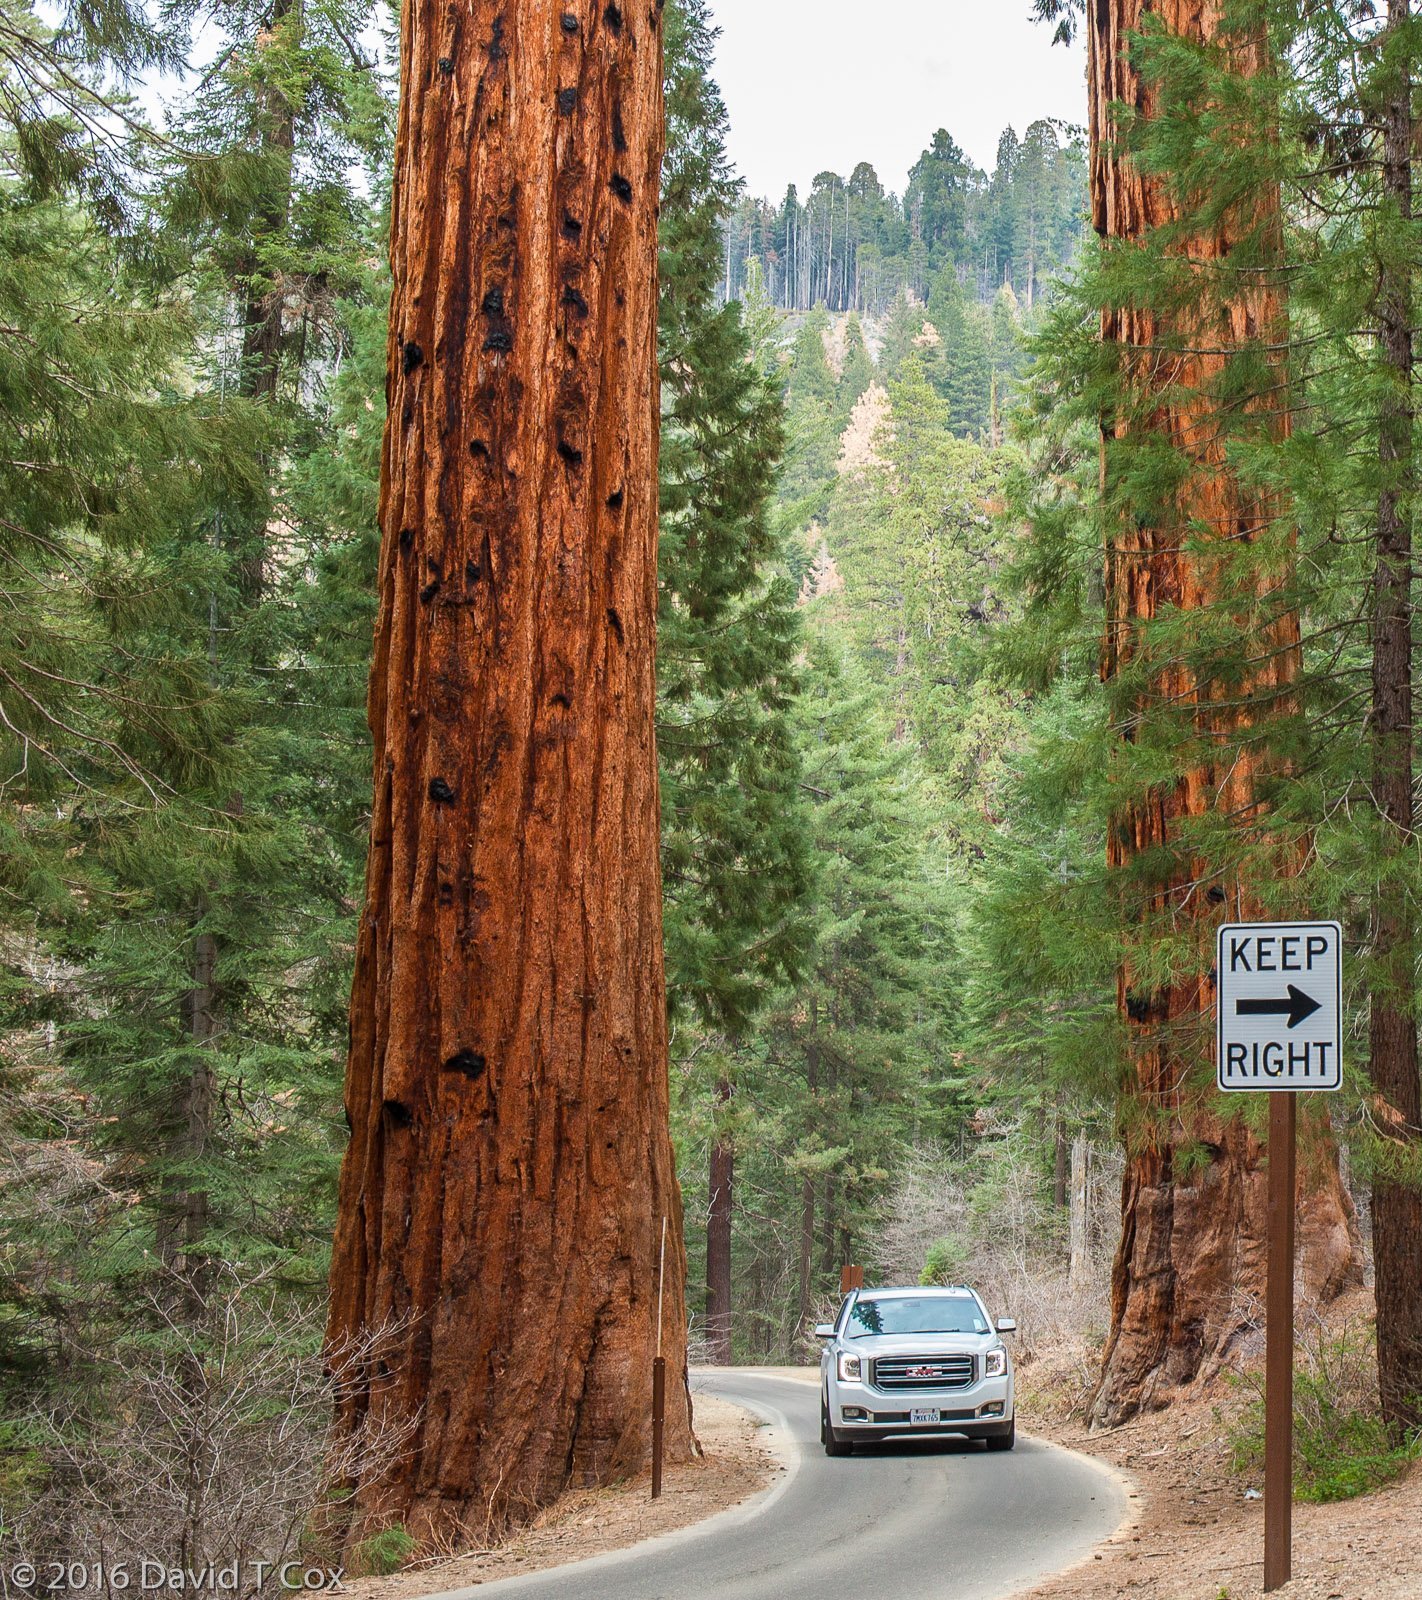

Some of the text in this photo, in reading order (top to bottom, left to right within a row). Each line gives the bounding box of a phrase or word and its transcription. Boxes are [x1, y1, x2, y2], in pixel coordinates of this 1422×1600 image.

[1230, 936, 1329, 972] KEEP
[1227, 1041, 1333, 1078] RIGHT
[905, 1366, 943, 1378] GMC
